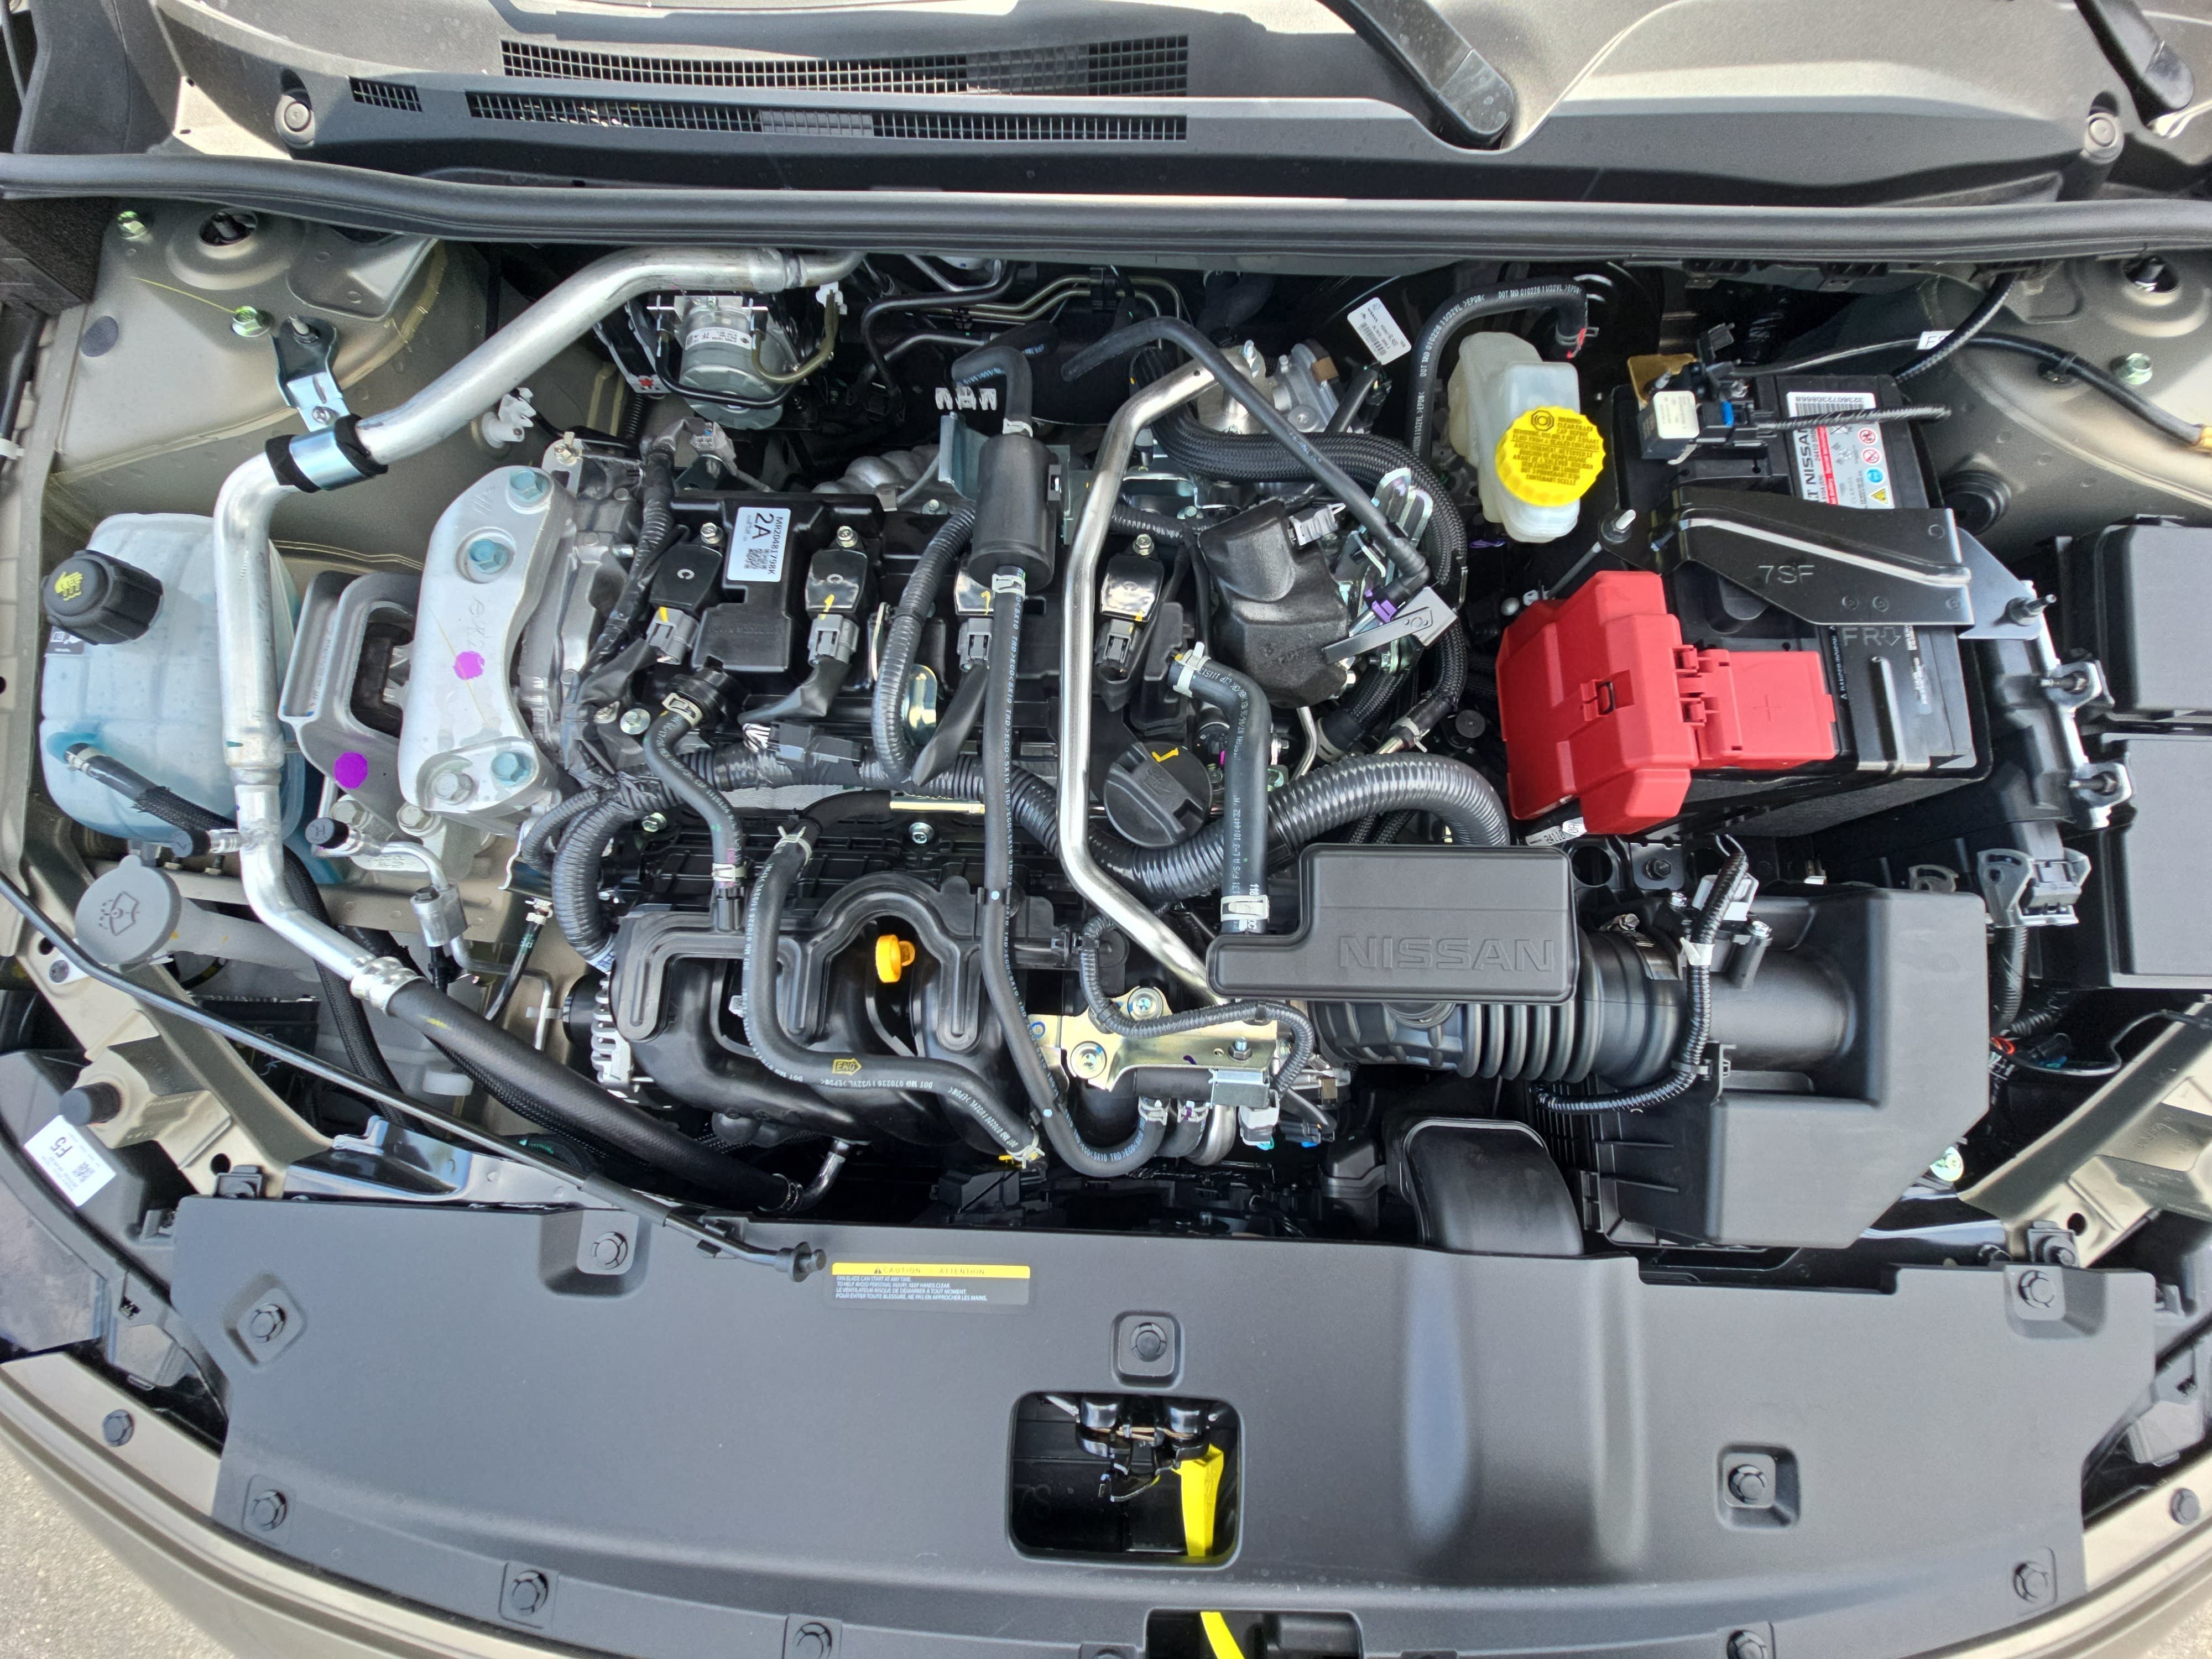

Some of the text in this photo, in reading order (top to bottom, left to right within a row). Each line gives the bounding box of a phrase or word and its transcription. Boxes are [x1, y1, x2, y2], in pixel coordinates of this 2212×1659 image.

[1498, 289, 1508, 299] DOT
[1420, 364, 1428, 378] DOT
[752, 512, 775, 540] 2A
[677, 569, 695, 580] C
[1758, 565, 1815, 585] 7SF
[1339, 935, 1554, 972] NISSAN
[836, 1061, 856, 1071] ENG
[920, 1080, 933, 1089] DOT
[50, 1136, 72, 1159] F5
